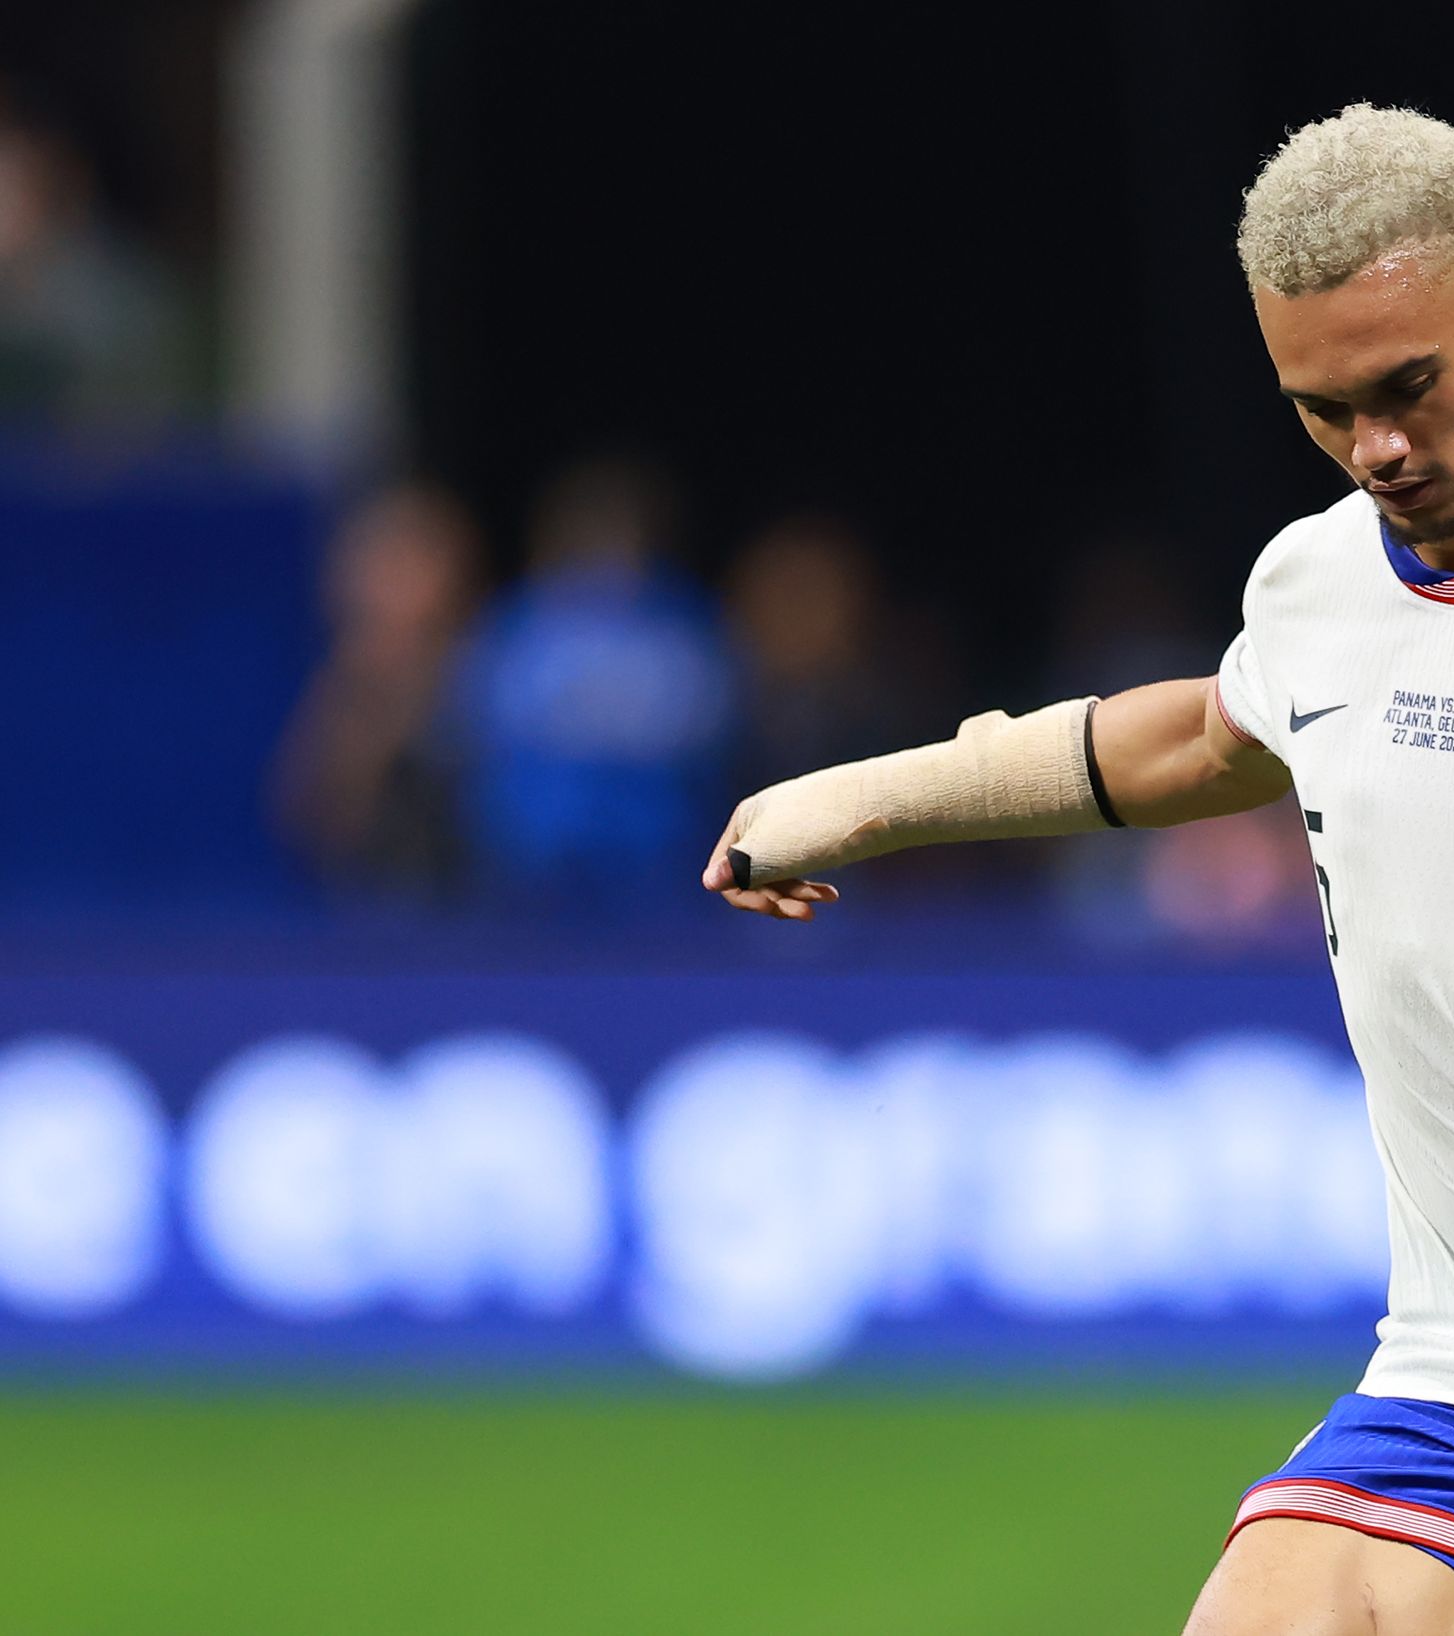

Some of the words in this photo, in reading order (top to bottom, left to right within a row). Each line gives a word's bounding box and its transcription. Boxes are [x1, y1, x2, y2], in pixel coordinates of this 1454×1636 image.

[1393, 690, 1436, 711] PANAMA
[1441, 697, 1454, 713] VS.
[1383, 708, 1434, 731] ATLANTA,
[1392, 728, 1407, 744] 27
[1409, 731, 1437, 749] JUNE
